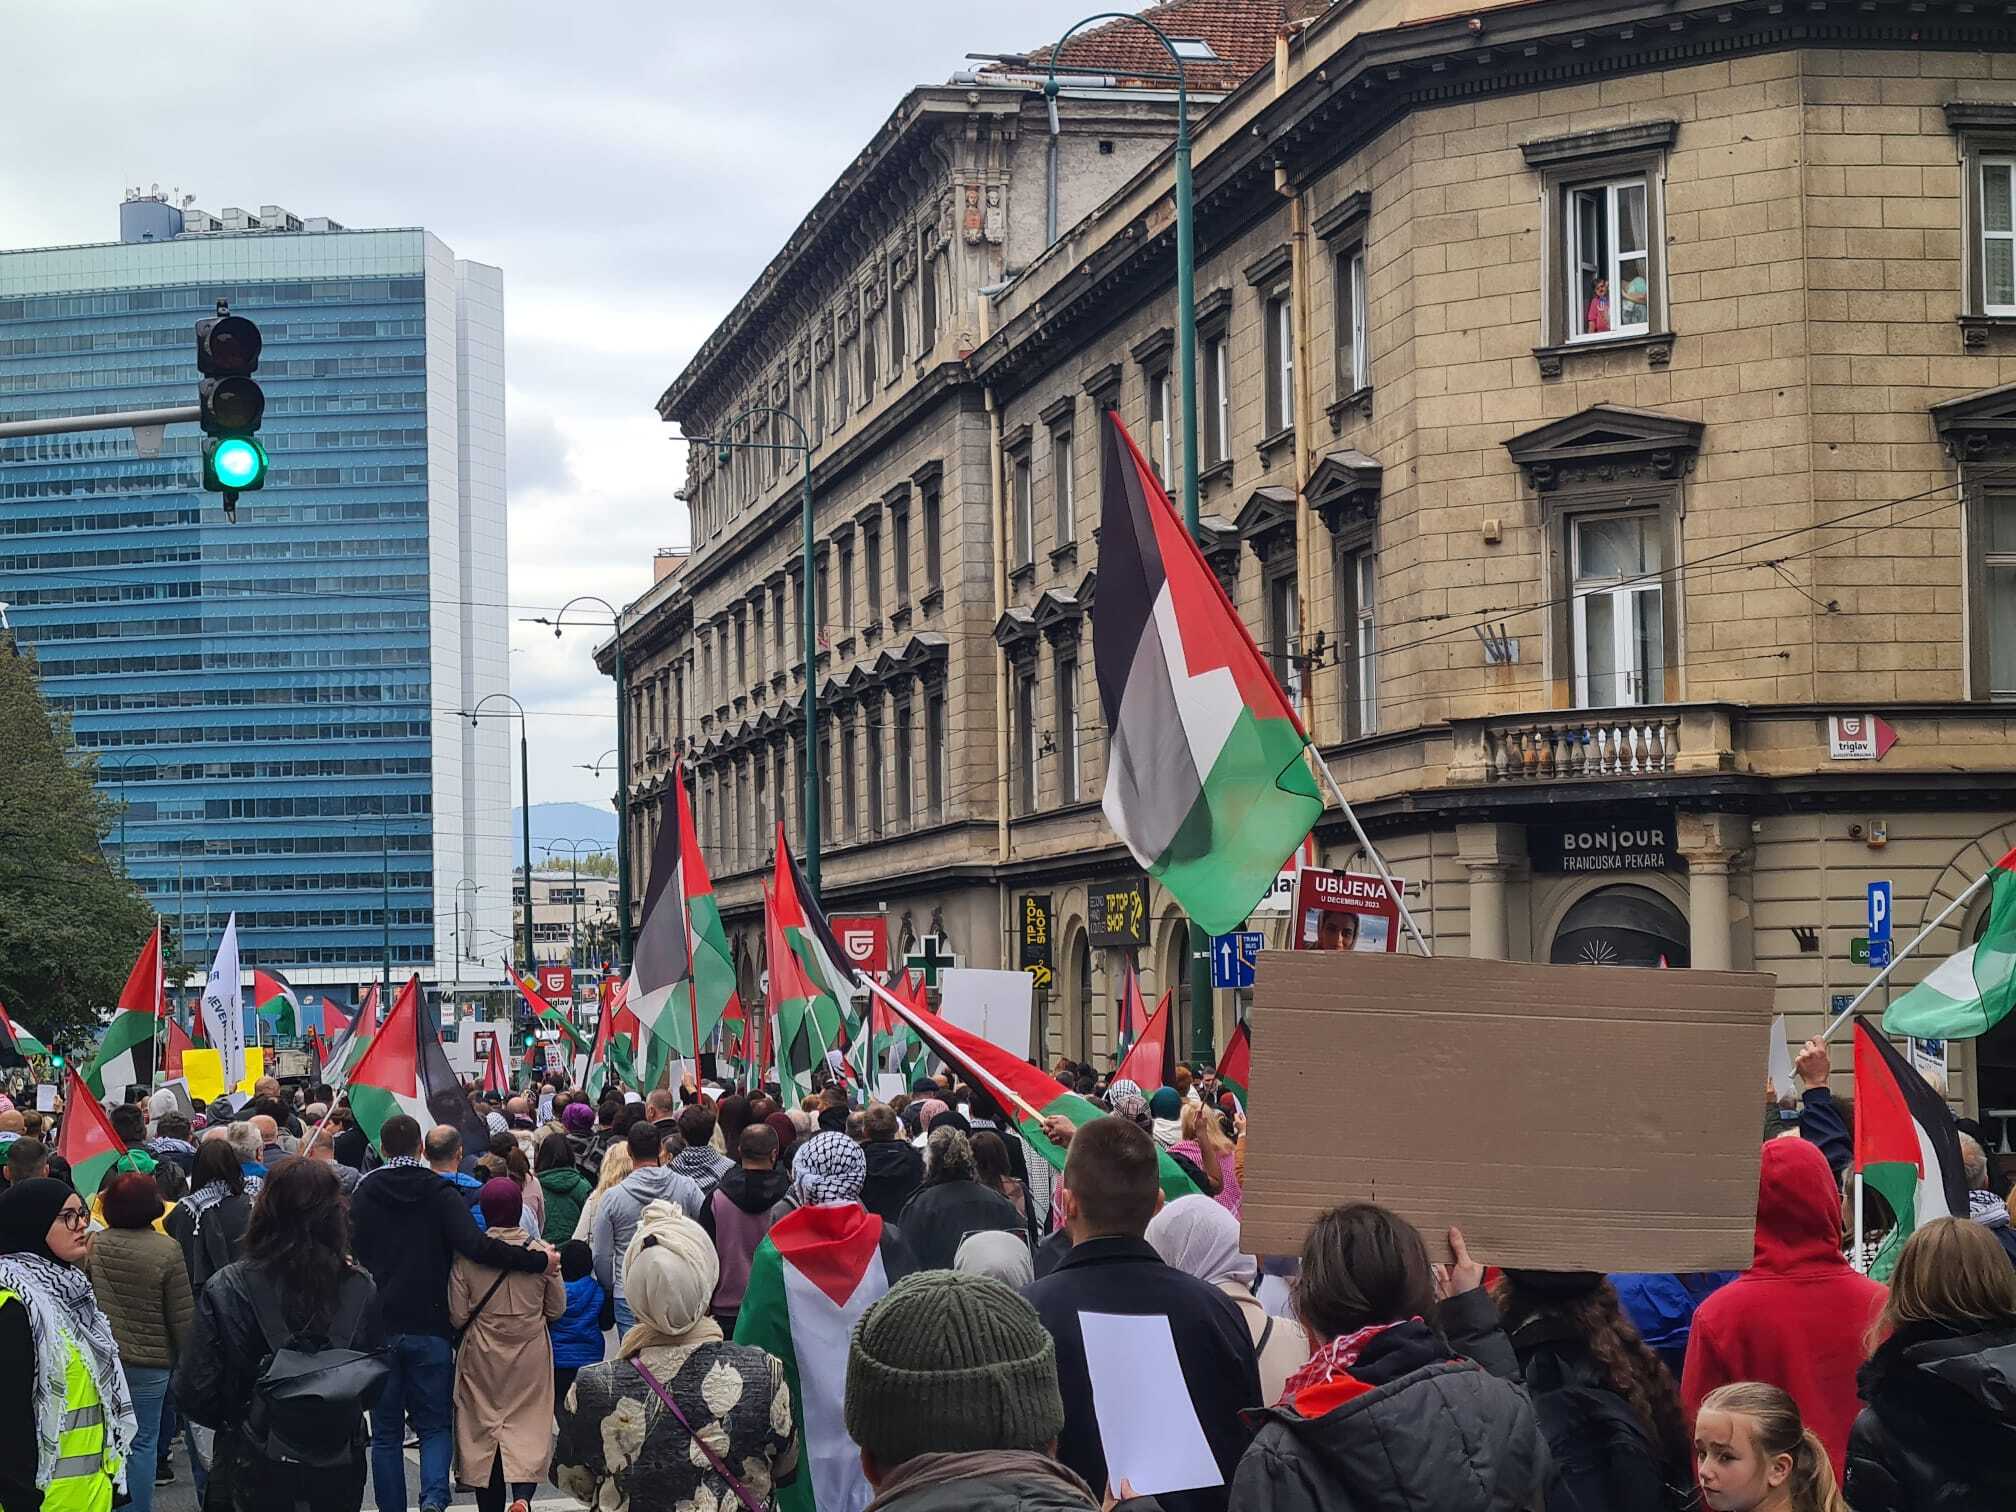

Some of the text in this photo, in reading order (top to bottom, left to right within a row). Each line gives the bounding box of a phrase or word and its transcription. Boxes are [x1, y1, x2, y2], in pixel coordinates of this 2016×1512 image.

[1839, 742, 1867, 752] triglav
[1563, 853, 1665, 871] FRANCUSKA PEKARA
[1315, 876, 1388, 899] UBIJENA
[1027, 898, 1036, 923] TOP
[1107, 894, 1116, 912] TIP
[1116, 892, 1129, 911] TOP
[1327, 896, 1363, 907] DECEMBRU
[1873, 890, 1886, 933] P
[1037, 909, 1046, 944] SHOP
[1107, 914, 1123, 932] SHOP
[1027, 925, 1036, 944] TIP
